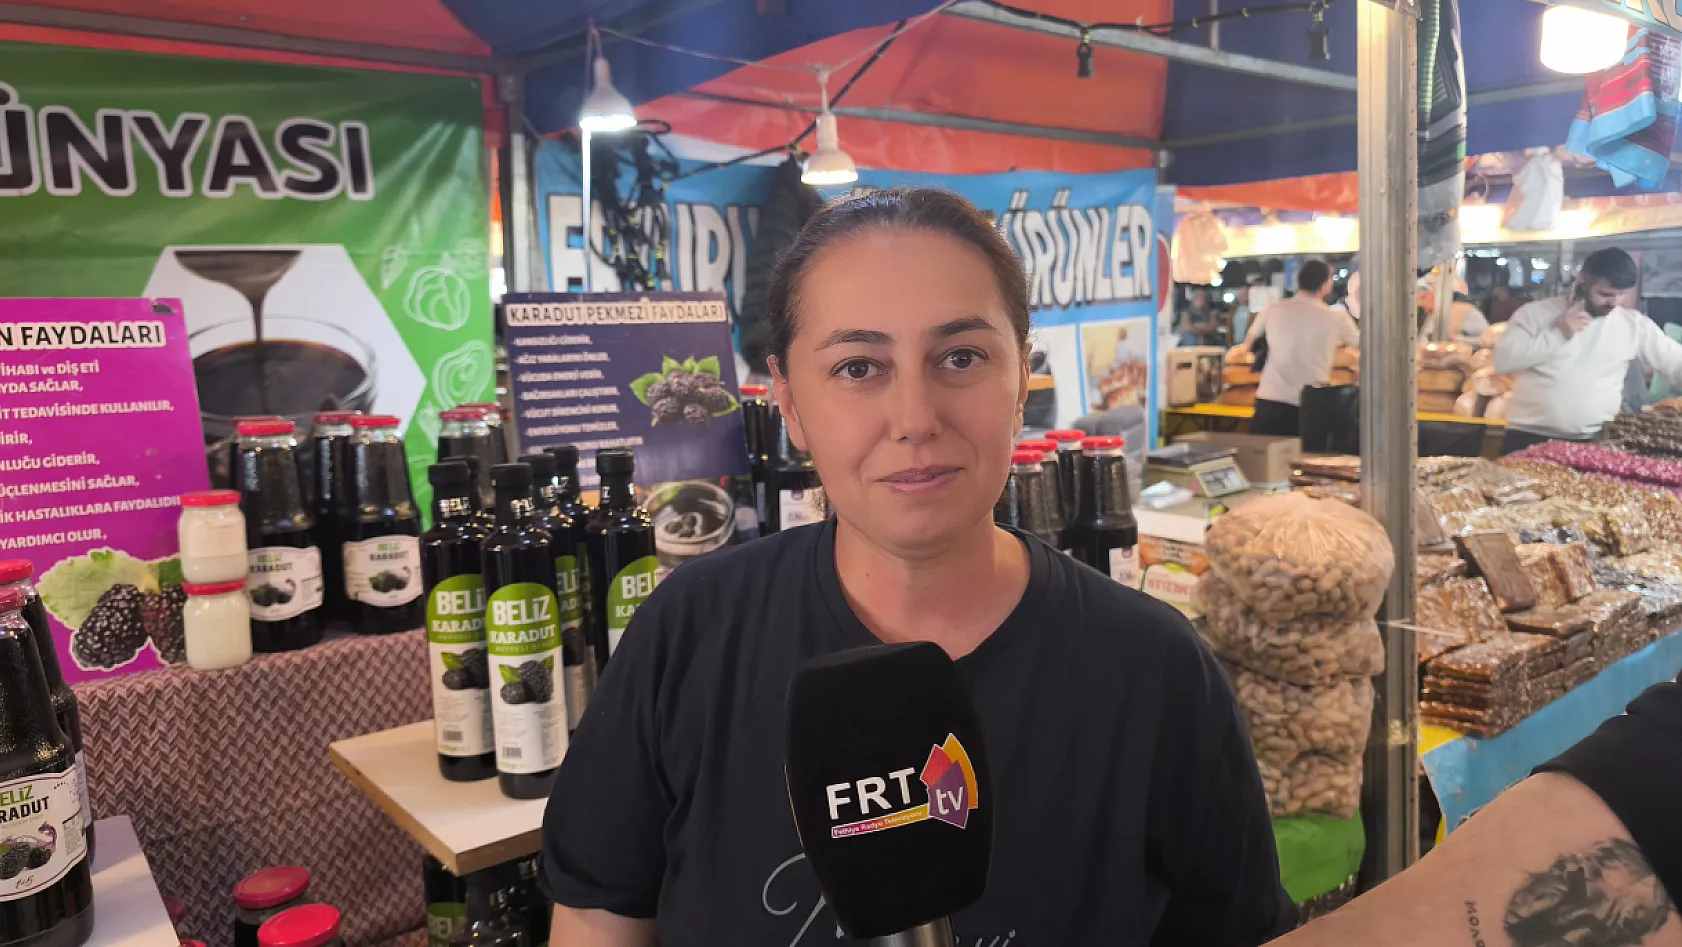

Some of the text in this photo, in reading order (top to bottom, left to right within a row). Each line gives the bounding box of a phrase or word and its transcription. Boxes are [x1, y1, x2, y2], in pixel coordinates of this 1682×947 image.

[510, 301, 724, 323] KARADUT PEKMEZİ FAYDALARI
[21, 325, 161, 346] FAYDALARI
[41, 366, 55, 375] ve
[57, 360, 79, 376] DİŞ
[80, 359, 99, 374] ETİ
[29, 378, 83, 393] SAĞLAR,
[11, 402, 99, 418] TEDAVİSİNDE
[100, 399, 174, 415] KULLANILIR,
[43, 451, 100, 468] GİDERİR,
[88, 474, 140, 490] SAĞLAR,
[16, 502, 112, 522] HASTALIKLARA
[0, 531, 65, 549] YARDIMCI
[489, 623, 556, 644] KARADUT
[826, 767, 916, 820] FRT
[935, 786, 964, 816] tv
[861, 820, 883, 832] Radyo
